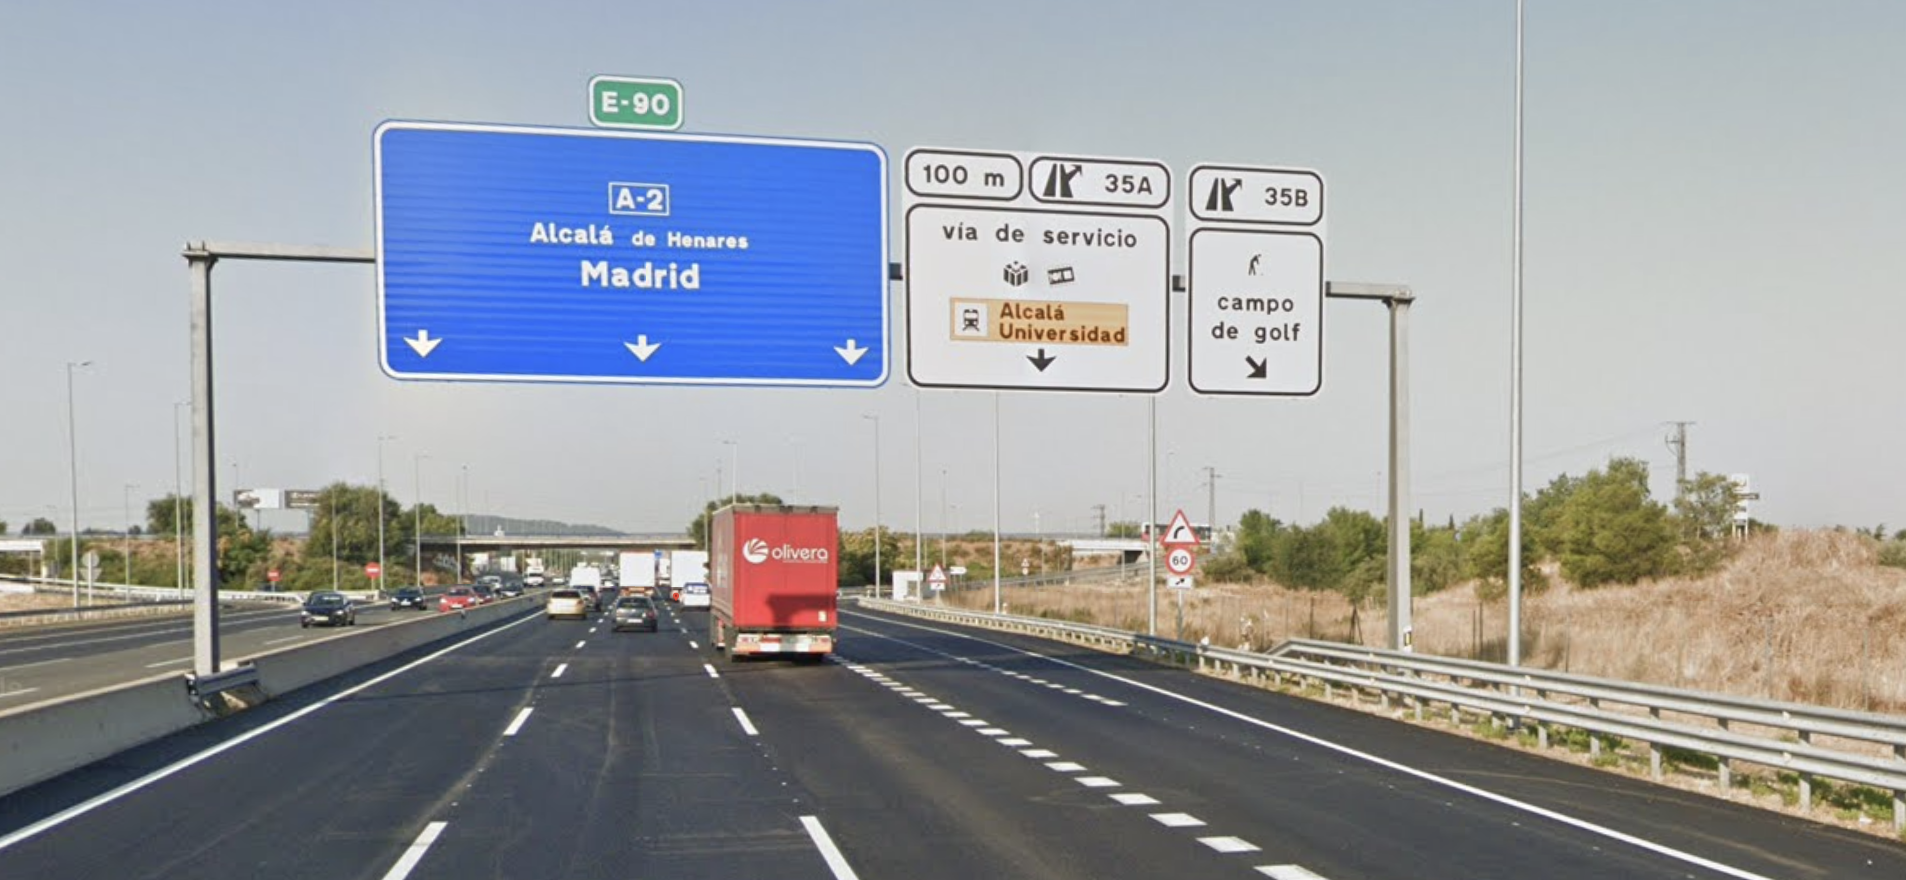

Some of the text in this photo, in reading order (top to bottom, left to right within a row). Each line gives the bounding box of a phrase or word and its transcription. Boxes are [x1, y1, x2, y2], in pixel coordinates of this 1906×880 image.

[601, 91, 669, 115] E-90
[923, 164, 1005, 187] 100 m
[1105, 173, 1153, 195] 35A
[616, 188, 663, 210] A-2
[1265, 187, 1309, 207] 35B
[530, 222, 749, 249] Alcalá de Henares
[942, 222, 1137, 248] vía de servicio
[581, 260, 700, 290] Madrid
[1000, 302, 1065, 321] Alcalá
[1217, 297, 1294, 315] campo
[999, 322, 1126, 343] Universidad
[1211, 321, 1301, 345] de golf
[771, 543, 829, 560] olivera
[1172, 555, 1188, 567] 60
